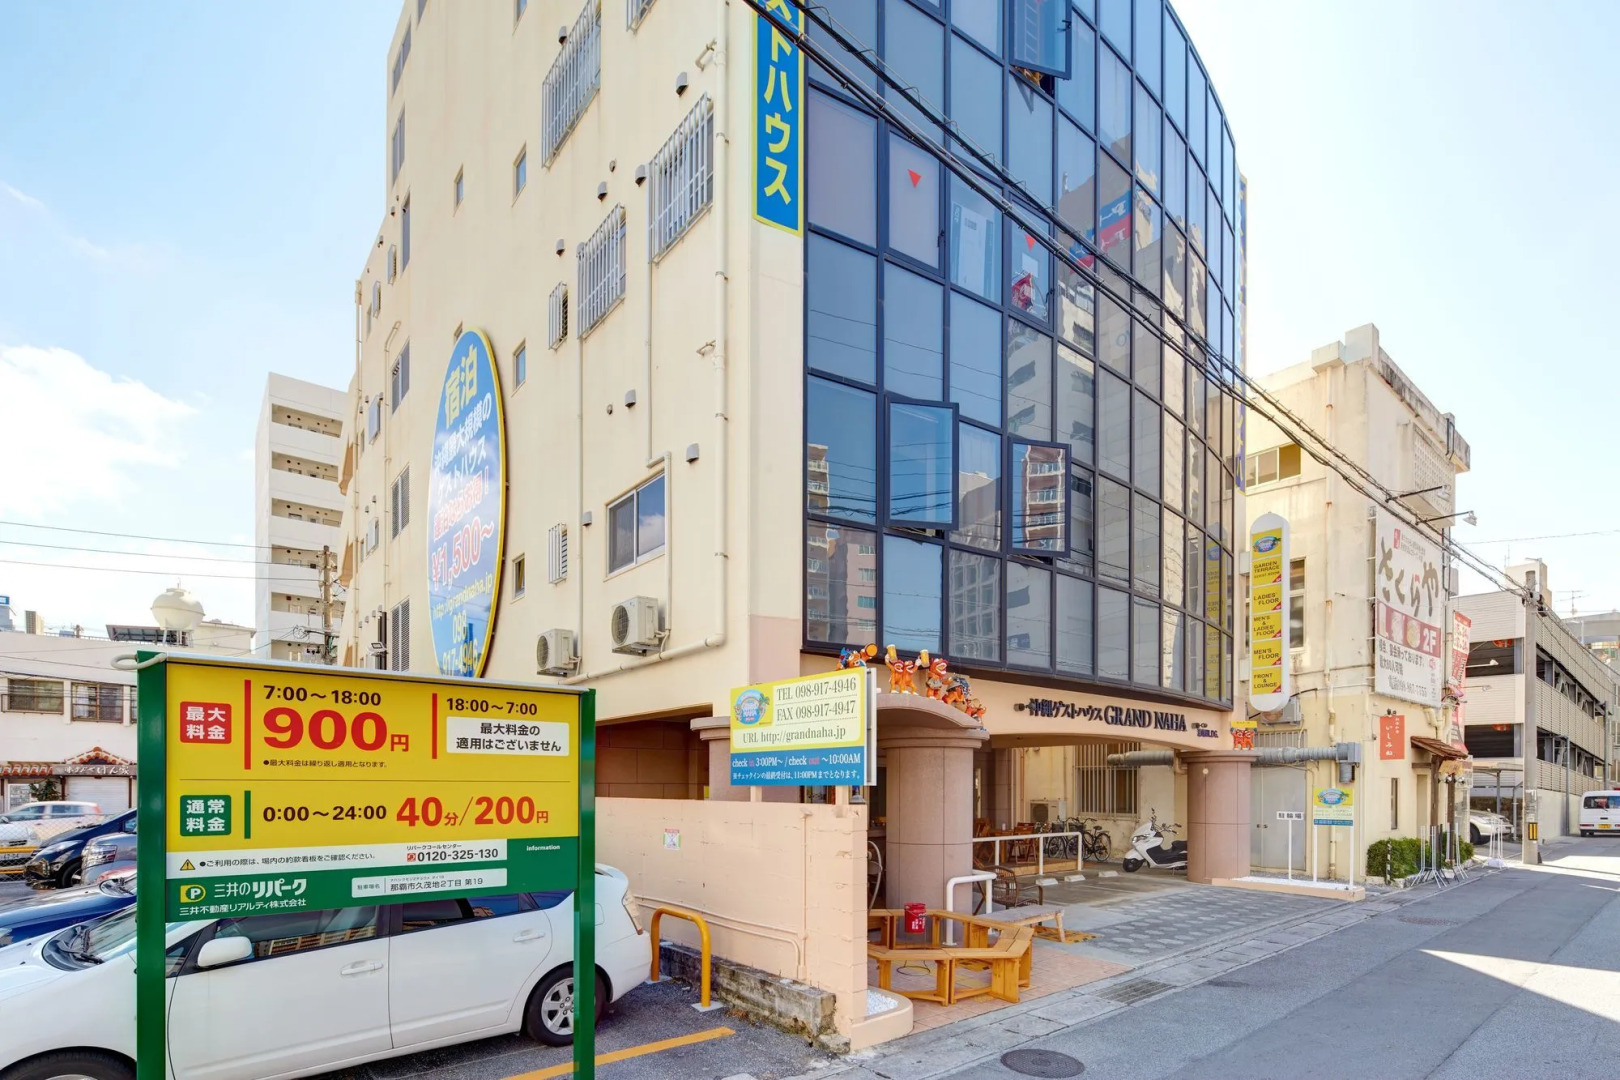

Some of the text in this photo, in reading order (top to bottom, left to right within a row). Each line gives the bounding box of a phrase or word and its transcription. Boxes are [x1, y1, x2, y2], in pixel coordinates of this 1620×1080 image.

[444, 344, 478, 429] 宿泊
[434, 392, 492, 473] 沖縄最大規模の
[437, 435, 486, 505] ゲストハウス
[1378, 537, 1438, 617] さくらや
[1258, 597, 1279, 605] FLOOR
[453, 610, 467, 644] 098
[1423, 627, 1436, 654] 2F
[1254, 647, 1272, 655] MEN'S
[1258, 652, 1279, 660] FLOOR
[777, 677, 856, 701] TEL 098-917-4946
[186, 706, 226, 722] 最大
[777, 707, 793, 721] FAX
[796, 700, 856, 720] 098-917-4947
[1029, 698, 1187, 731] 沖縄ゲストハウス GRAND NAHA
[186, 724, 226, 740] 料金
[480, 722, 540, 736] 最大料金の
[743, 725, 846, 744] URL http://grandnaha.jp
[456, 737, 562, 752] 適用はございません
[732, 758, 748, 767] check
[788, 756, 807, 766] check
[186, 799, 225, 814] 通常
[186, 816, 225, 832] 料金
[417, 848, 499, 862] 0120-325-130
[390, 877, 484, 892] 那覇市久茂地2丁目 第19
[179, 899, 306, 915] 三井不動産リアルティ株式会社
